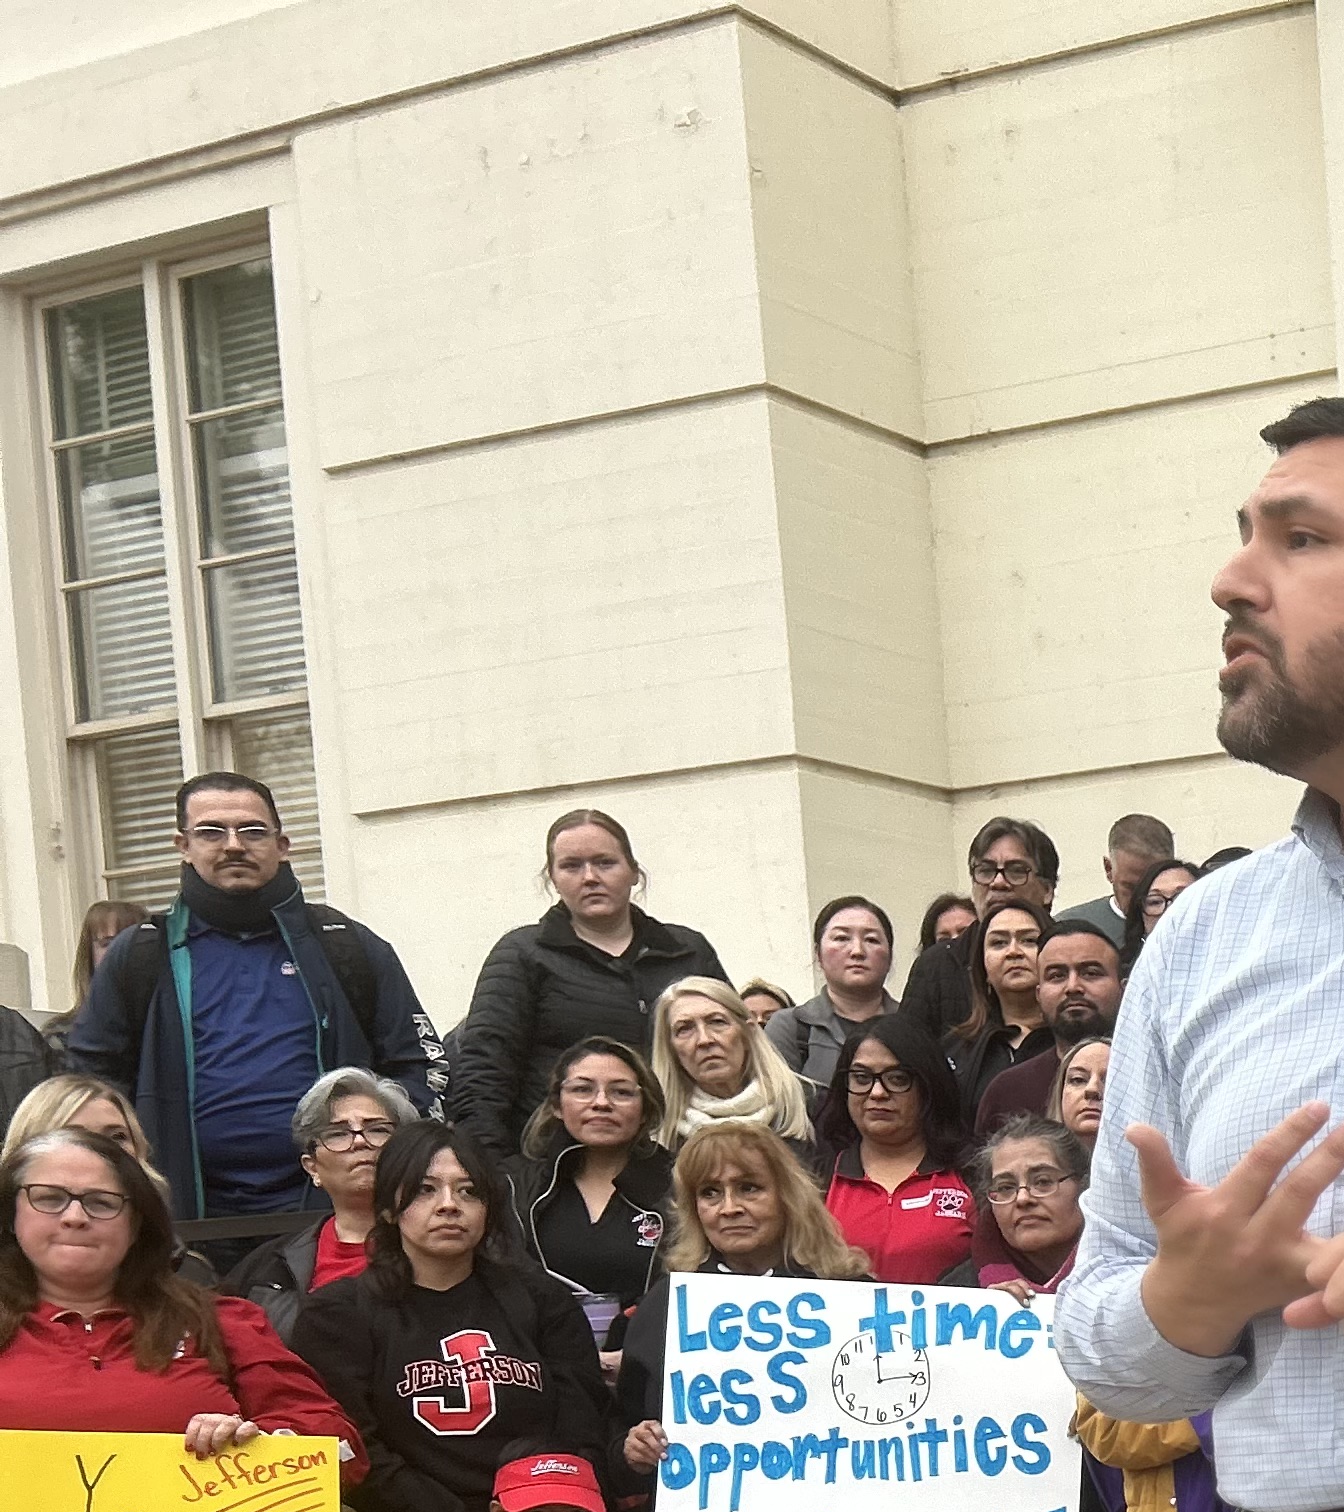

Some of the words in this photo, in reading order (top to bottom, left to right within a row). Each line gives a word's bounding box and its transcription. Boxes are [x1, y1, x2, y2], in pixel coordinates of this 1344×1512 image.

[676, 1285, 832, 1354] Less
[397, 1355, 543, 1398] JEFFERSON
[669, 1351, 808, 1426] less
[179, 1449, 328, 1502] Jefferson
[660, 1412, 1052, 1512] opportunities
